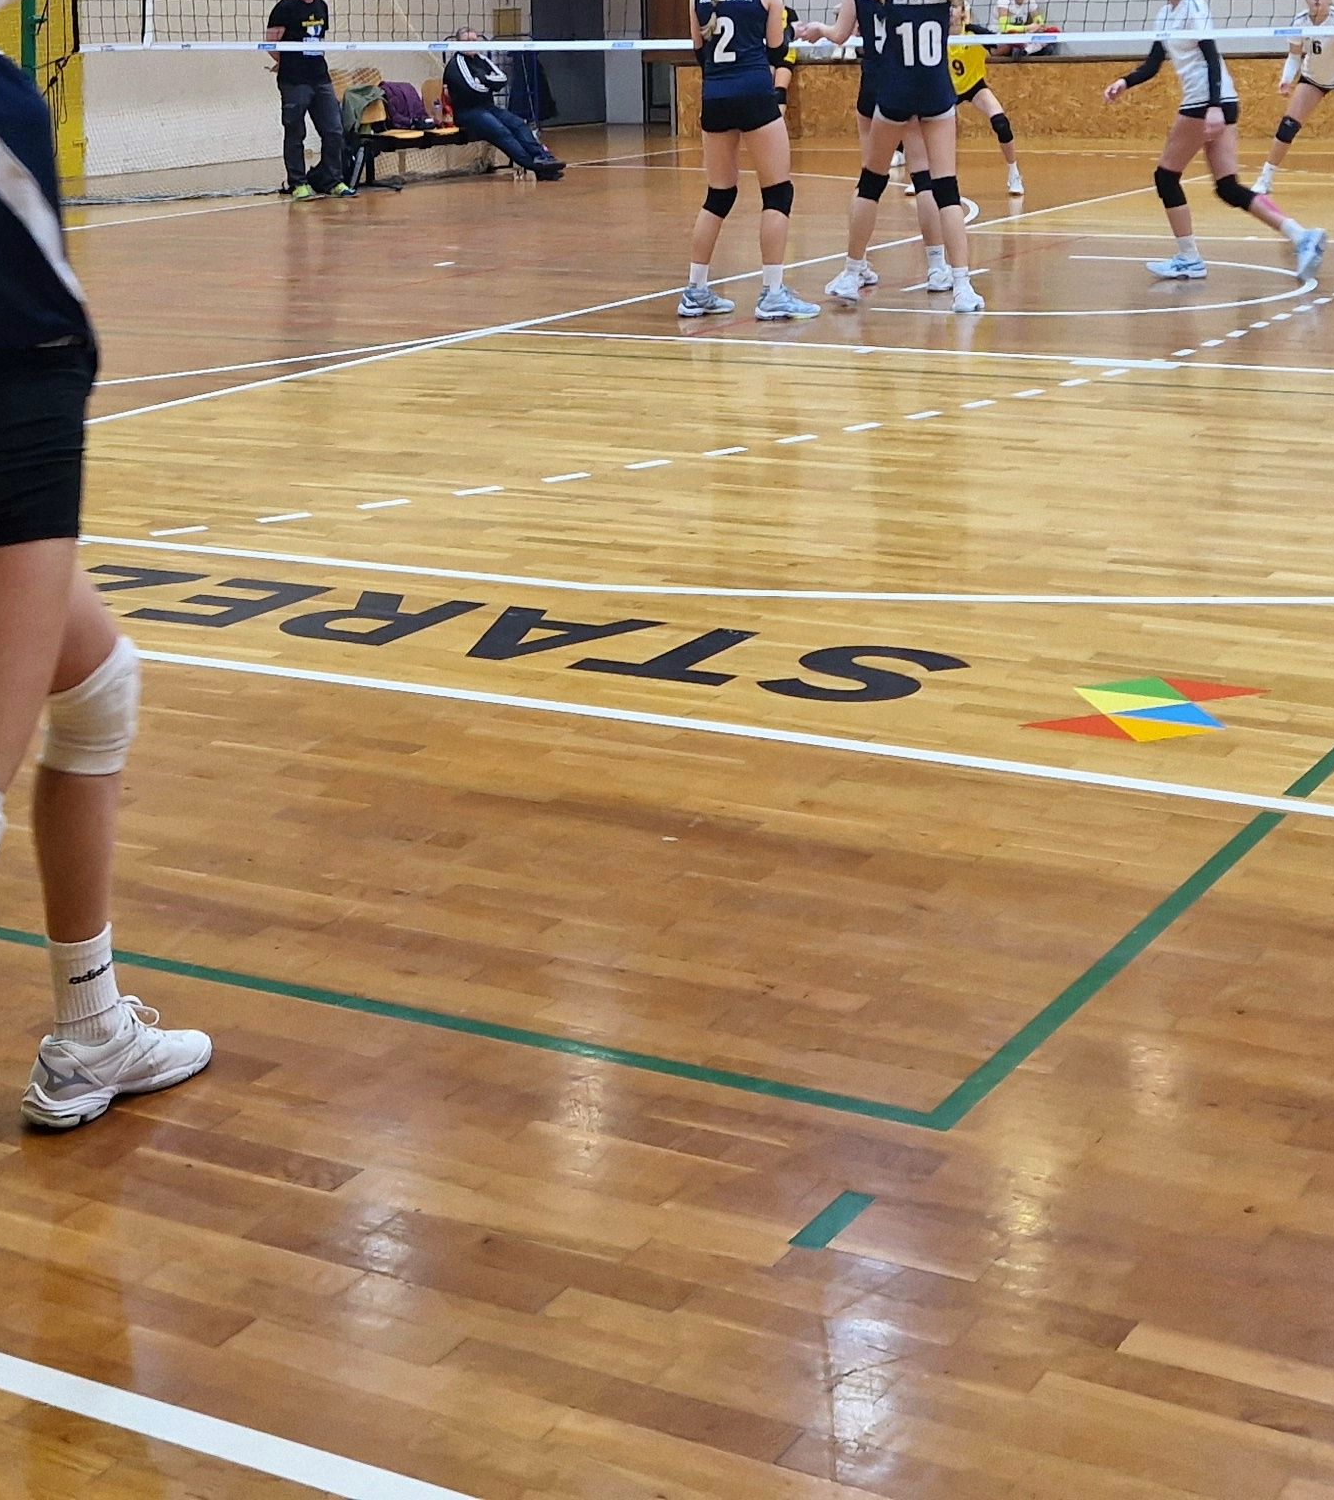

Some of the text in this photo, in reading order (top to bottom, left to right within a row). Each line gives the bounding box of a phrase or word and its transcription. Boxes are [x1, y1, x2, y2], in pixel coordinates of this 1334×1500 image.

[713, 16, 736, 64] 2
[895, 20, 943, 67] 10
[952, 59, 965, 76] 9
